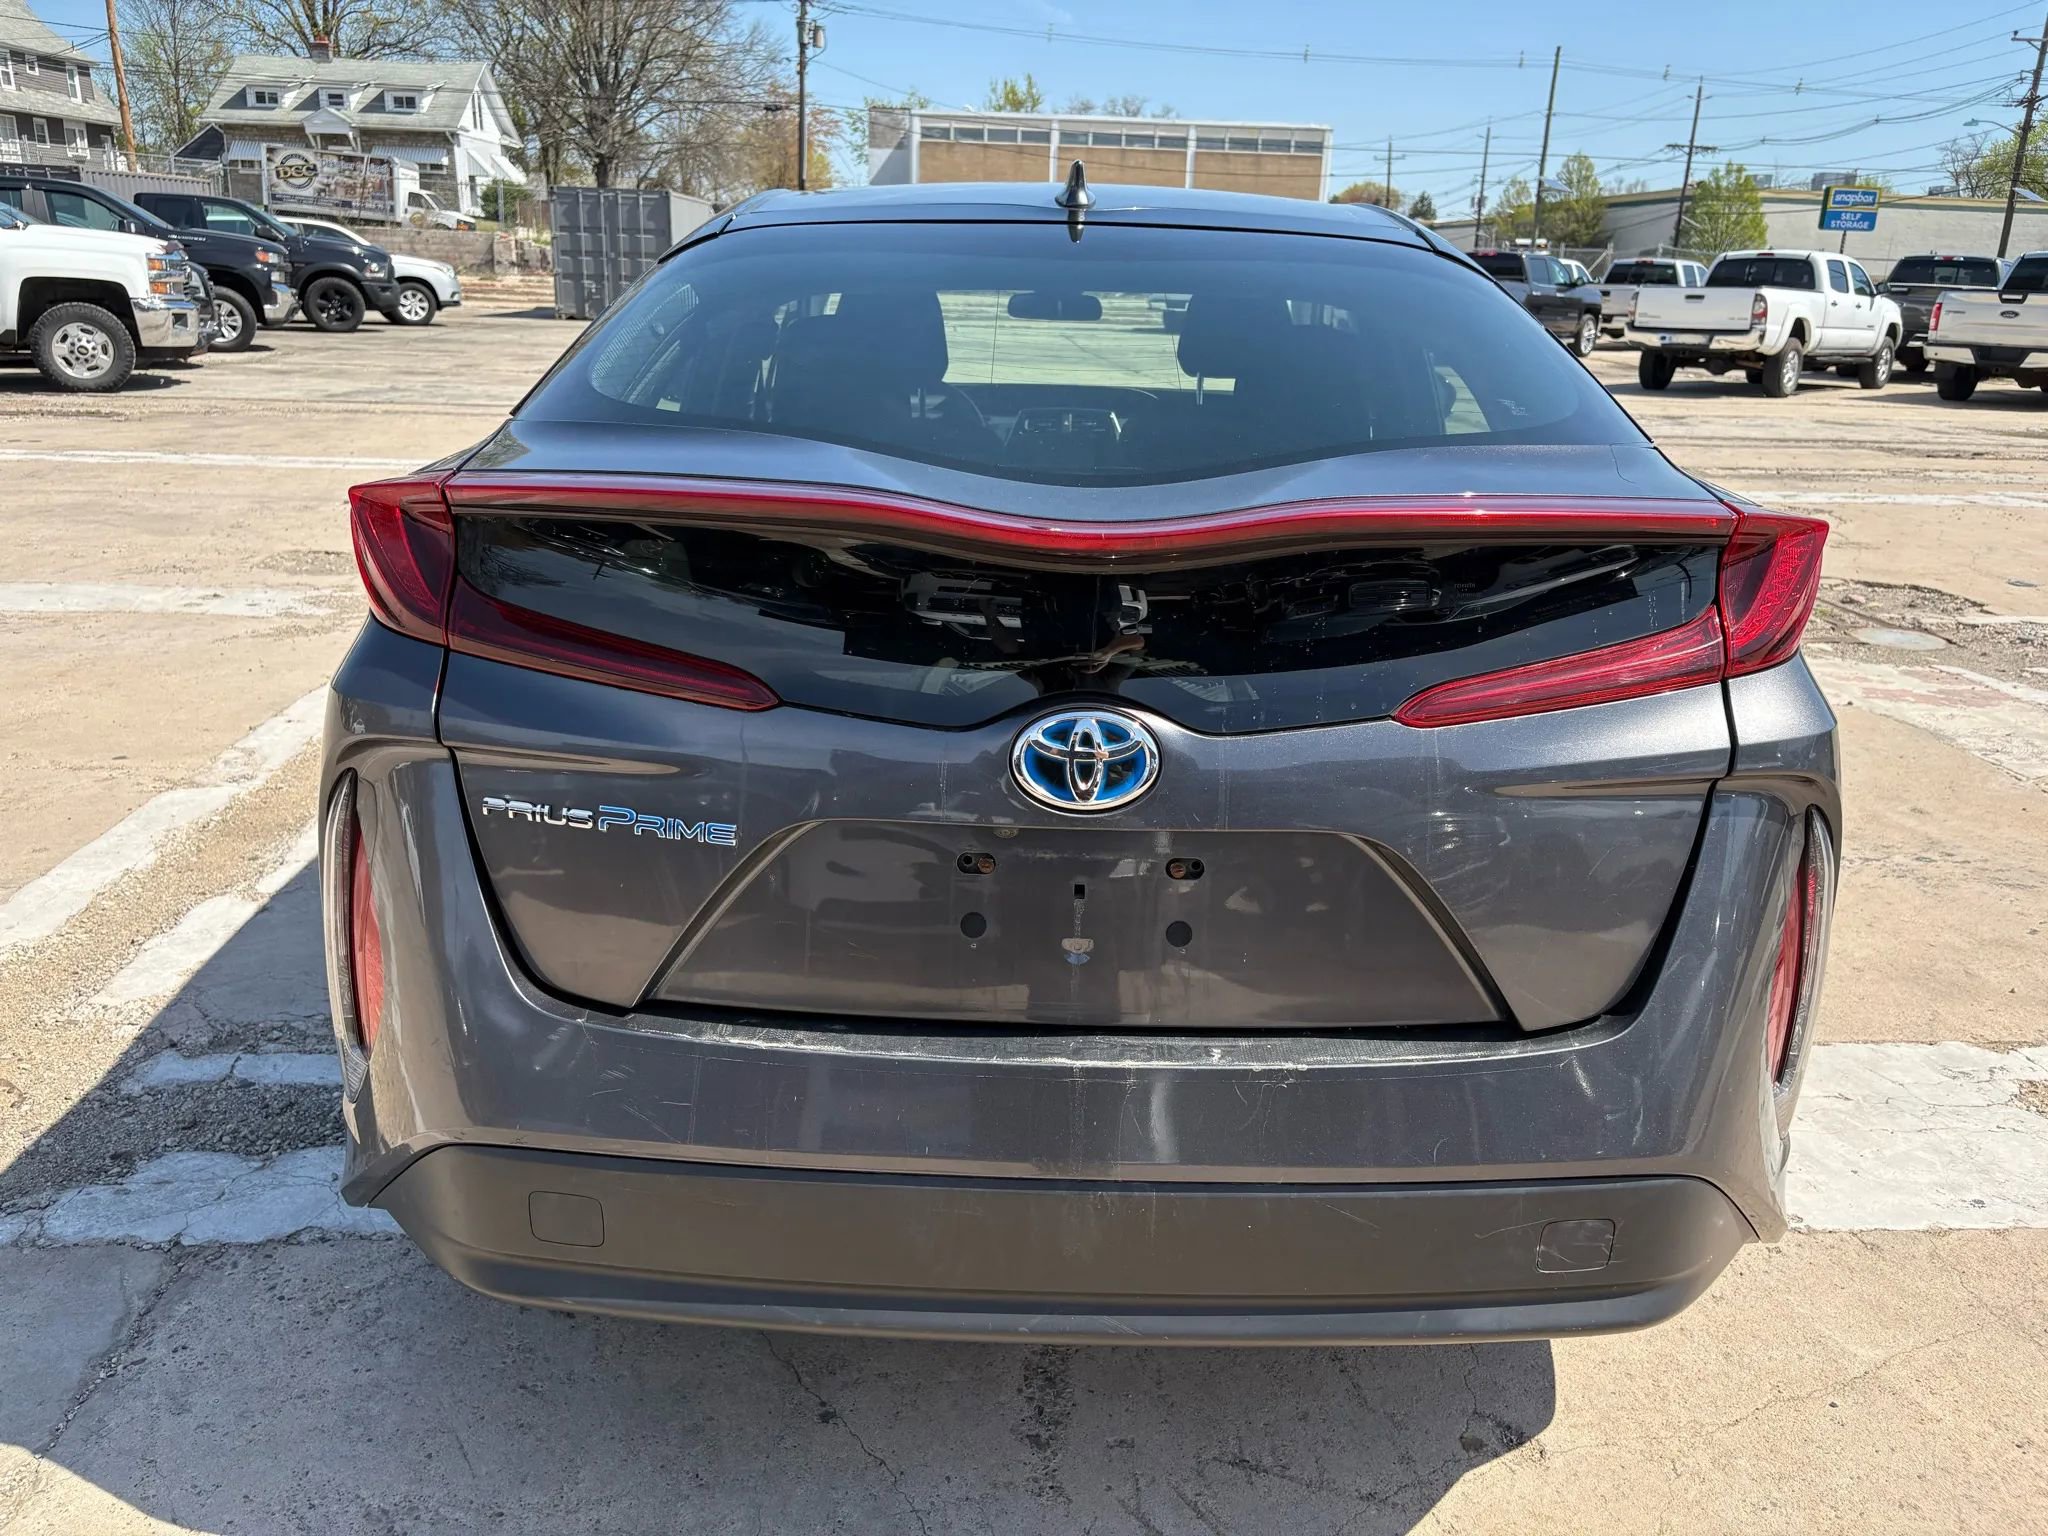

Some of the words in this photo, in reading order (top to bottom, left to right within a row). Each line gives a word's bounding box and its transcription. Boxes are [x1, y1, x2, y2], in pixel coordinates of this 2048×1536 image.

[1834, 191, 1875, 206] snapbox
[1840, 212, 1862, 221] SELF
[1830, 220, 1869, 230] STORAGE
[482, 797, 594, 829] PRIUS
[598, 805, 737, 847] PRIME
